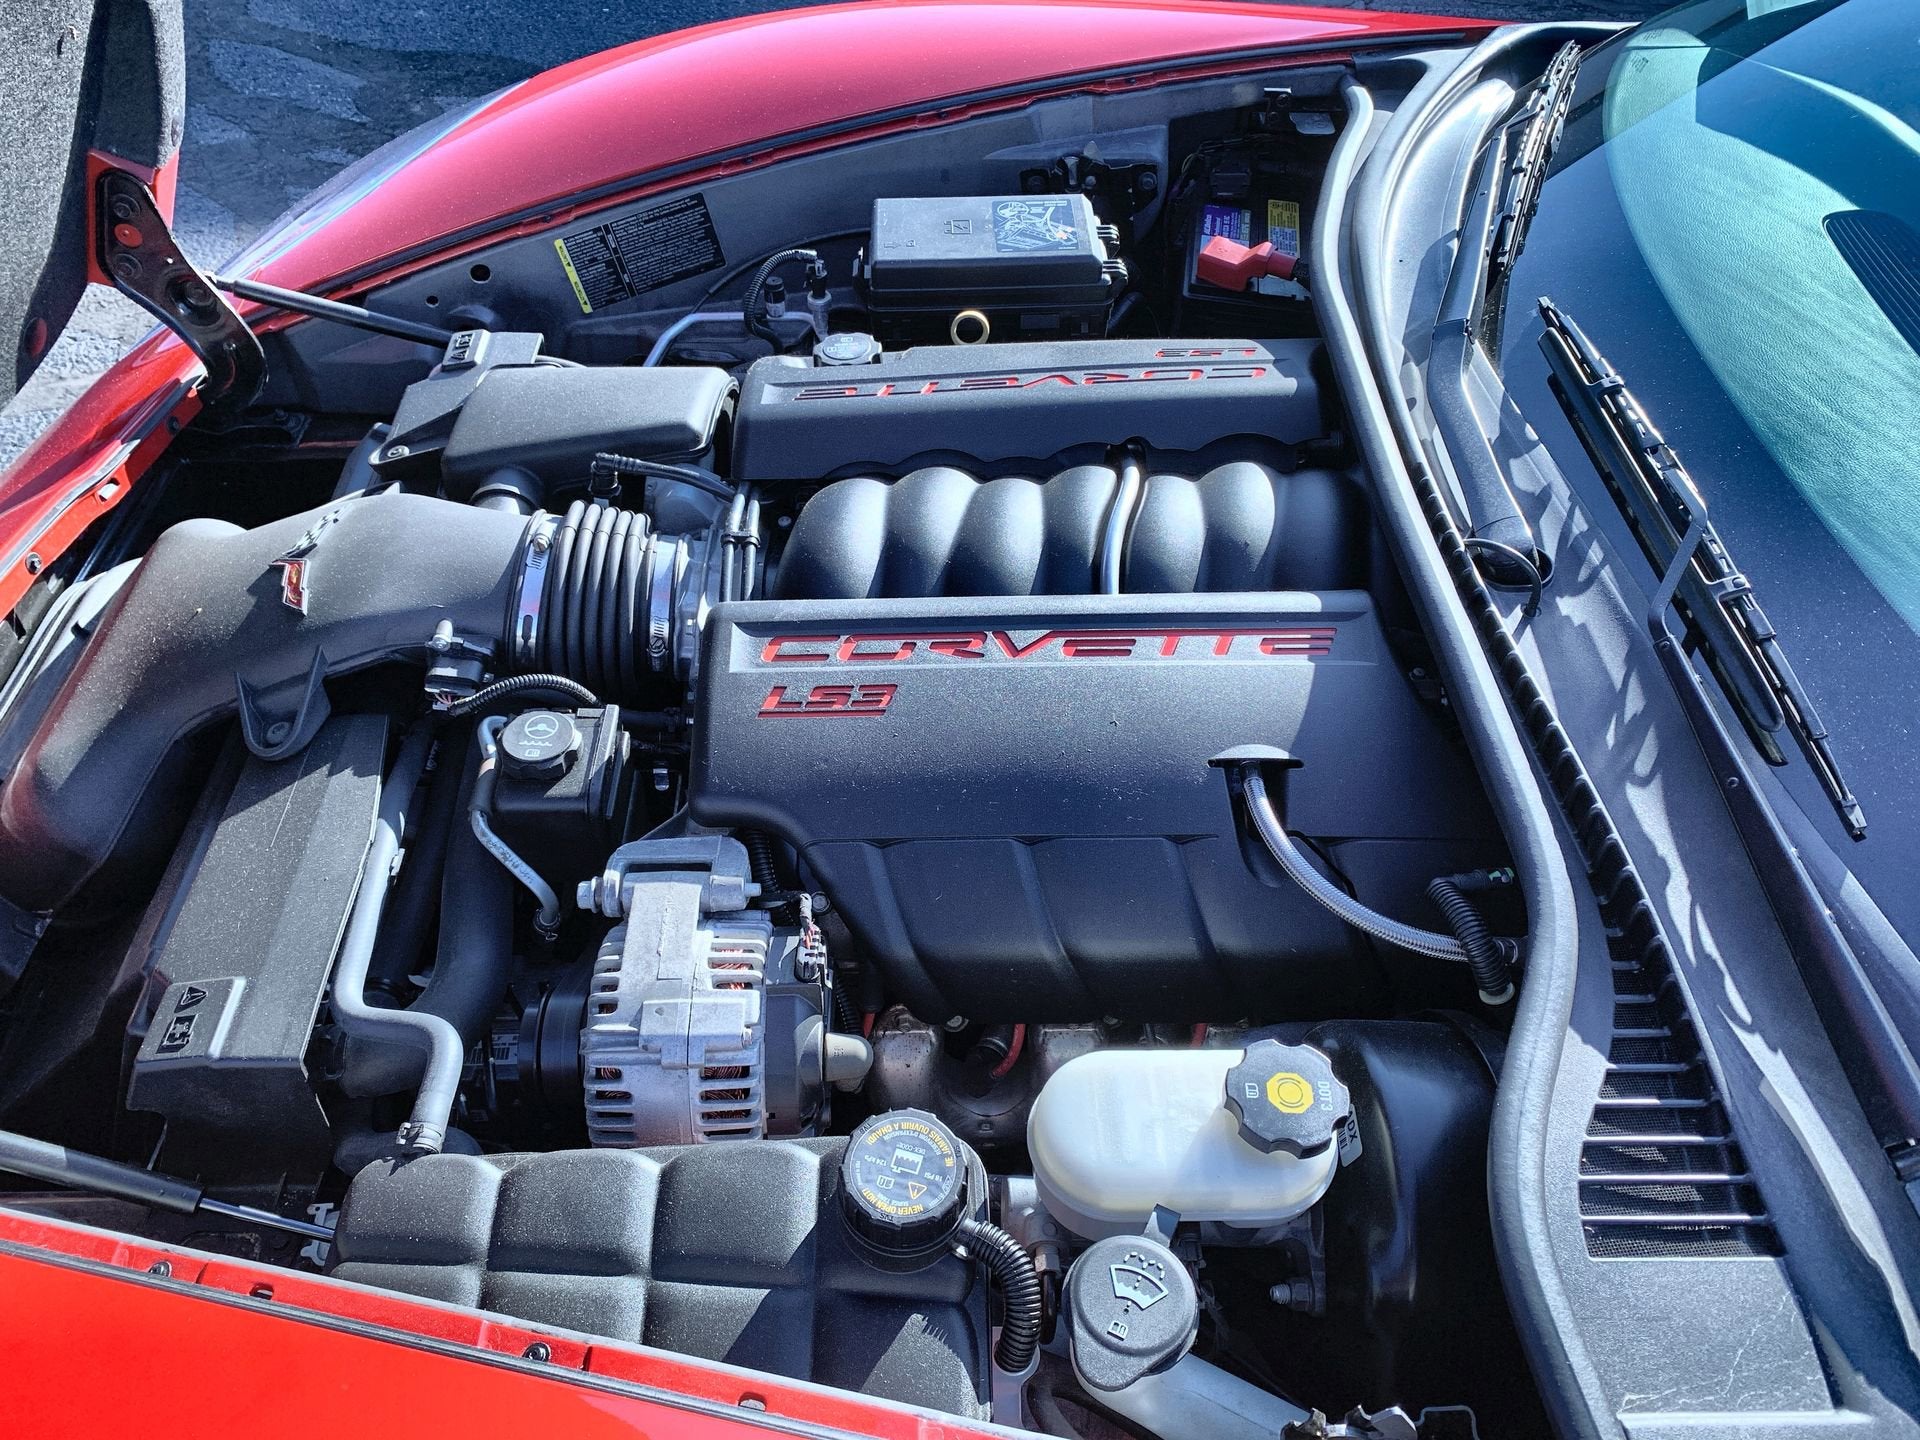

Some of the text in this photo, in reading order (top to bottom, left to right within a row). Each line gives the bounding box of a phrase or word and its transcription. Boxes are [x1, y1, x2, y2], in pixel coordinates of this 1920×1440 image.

[793, 367, 1267, 401] CORVETTE
[761, 627, 1338, 662] CORVETTE
[758, 683, 899, 718] LS3
[1317, 1080, 1333, 1111] DOT 3
[901, 1121, 929, 1134] OUVRIR
[929, 1130, 952, 1155] JAMAIS
[944, 1155, 954, 1167] NE
[924, 1172, 935, 1181] PSI
[876, 1200, 897, 1214] OPEN
[898, 1203, 925, 1216] NEVER
